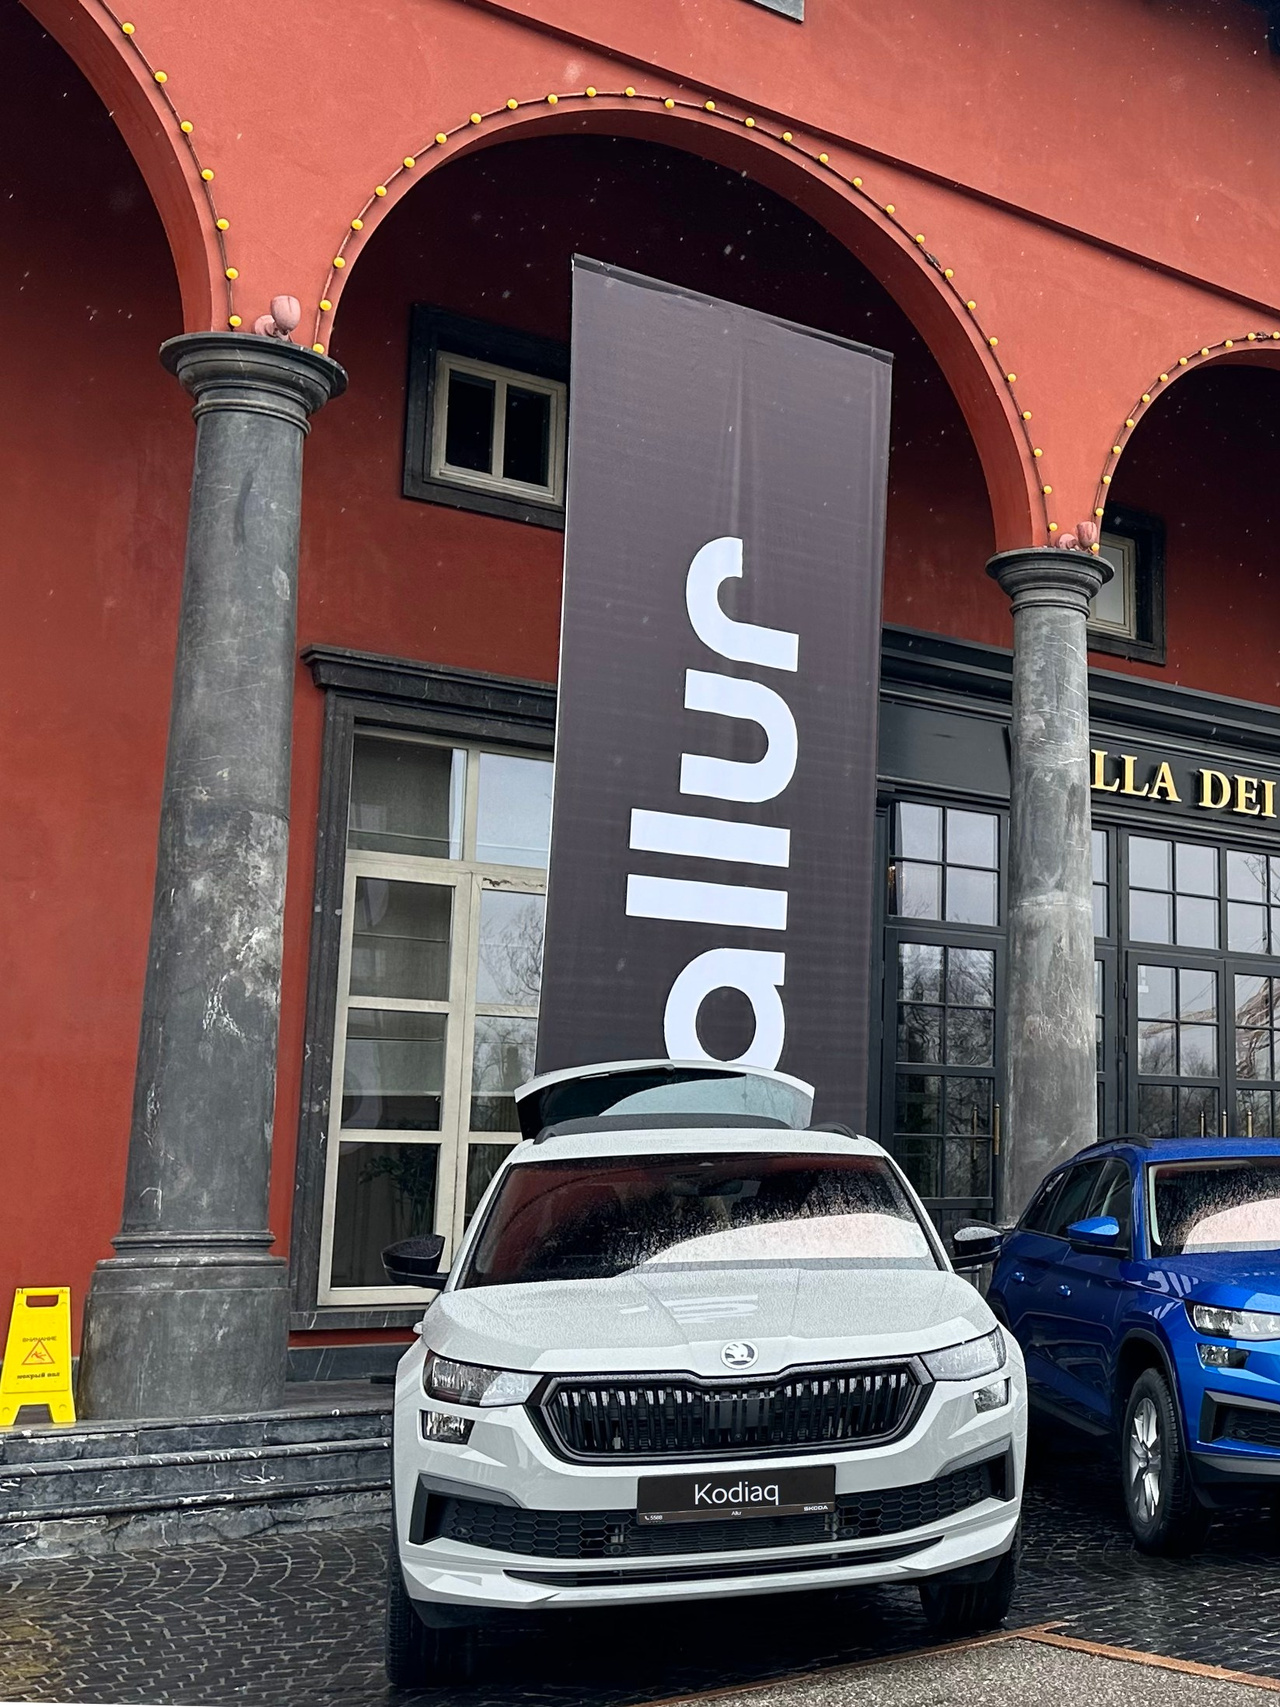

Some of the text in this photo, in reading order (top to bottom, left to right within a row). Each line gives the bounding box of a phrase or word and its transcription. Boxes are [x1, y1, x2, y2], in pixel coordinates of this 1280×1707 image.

[626, 536, 799, 1071] allur
[1090, 748, 1182, 802] LLA
[1198, 768, 1277, 818] DEI
[694, 1481, 779, 1506] Kodiaq
